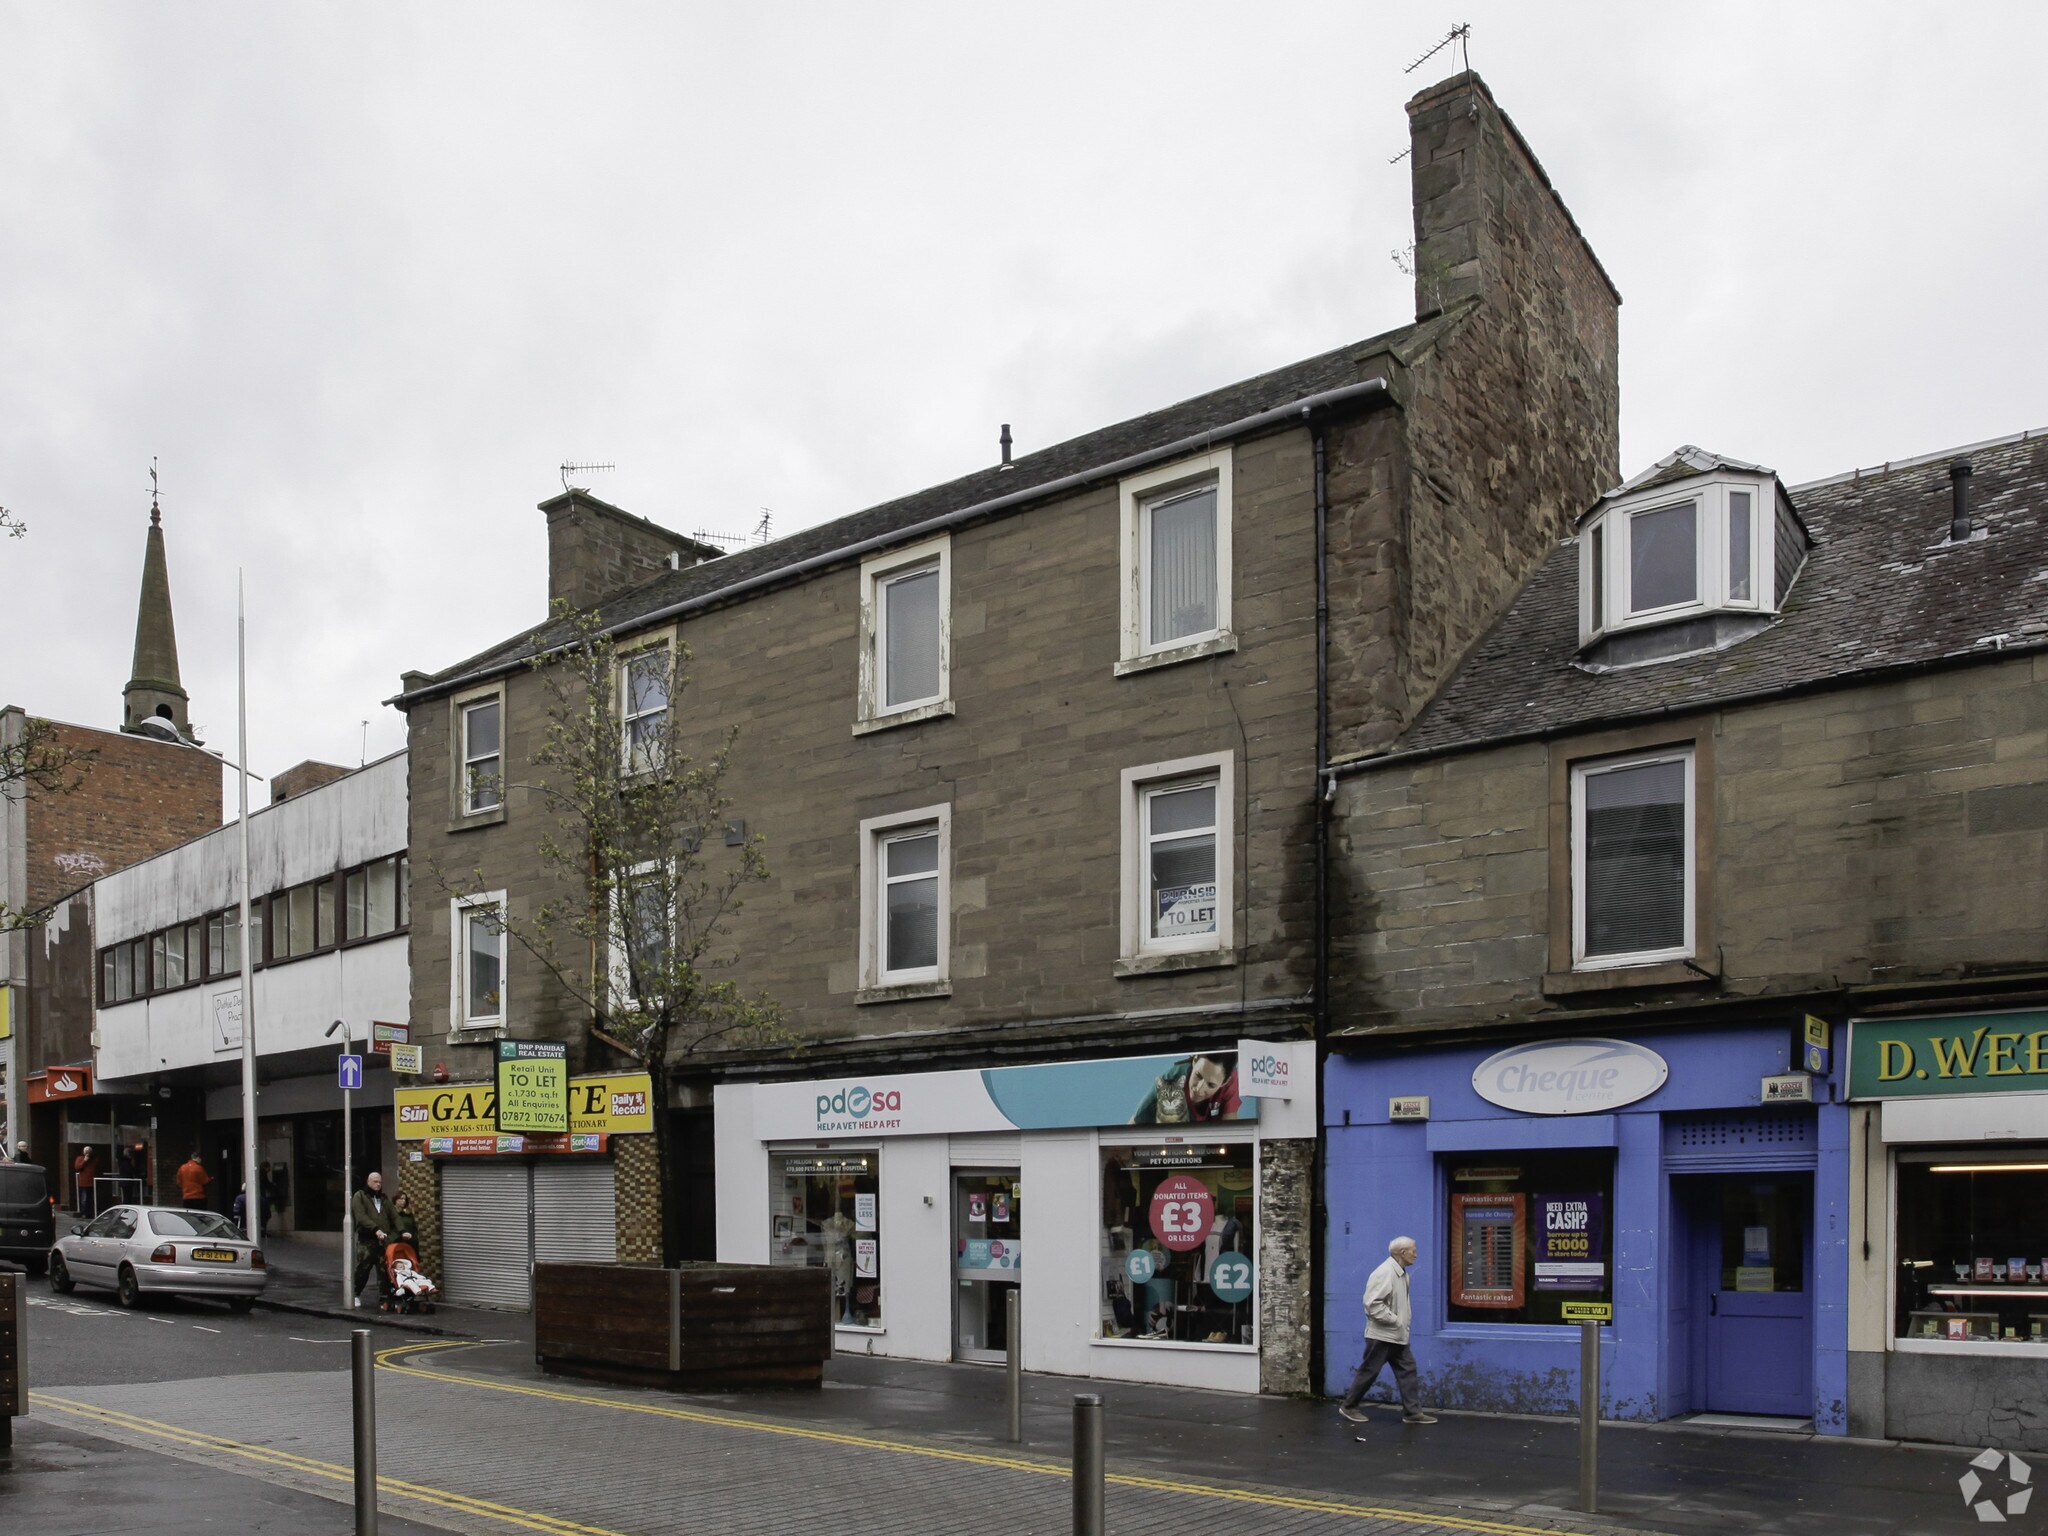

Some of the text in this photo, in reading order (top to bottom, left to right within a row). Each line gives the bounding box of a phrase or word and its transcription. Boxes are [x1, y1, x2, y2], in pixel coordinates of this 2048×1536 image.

[1161, 886, 1216, 904] BURNSID
[1168, 907, 1215, 925] TO LET
[535, 1044, 565, 1052] PARIBAS
[511, 1064, 535, 1072] Retail
[509, 1074, 557, 1087] TO LET
[1497, 1064, 1618, 1101] Cheque
[540, 1091, 558, 1099] sq.ft
[612, 1093, 634, 1106] Daily
[1575, 1090, 1613, 1101] centre
[522, 1101, 560, 1109] Enquiries
[612, 1103, 645, 1115] Record
[401, 1107, 428, 1121] Sun
[502, 1111, 565, 1123] 07872 107674
[431, 1125, 449, 1133] NEWS
[569, 1120, 607, 1128] CTIONARY
[817, 1119, 900, 1130] HELP A VET HELP A PET
[572, 1137, 597, 1146] Scot-Ads
[1546, 1202, 1587, 1211] NEED EXTRA
[1161, 1202, 1202, 1232] £3
[1546, 1212, 1588, 1229] CASH?
[1547, 1239, 1589, 1250] £1000
[1130, 1256, 1151, 1275] £1
[1214, 1263, 1251, 1289] £2
[1461, 1293, 1492, 1301] Fantastic
[1592, 1307, 1605, 1315] WU
